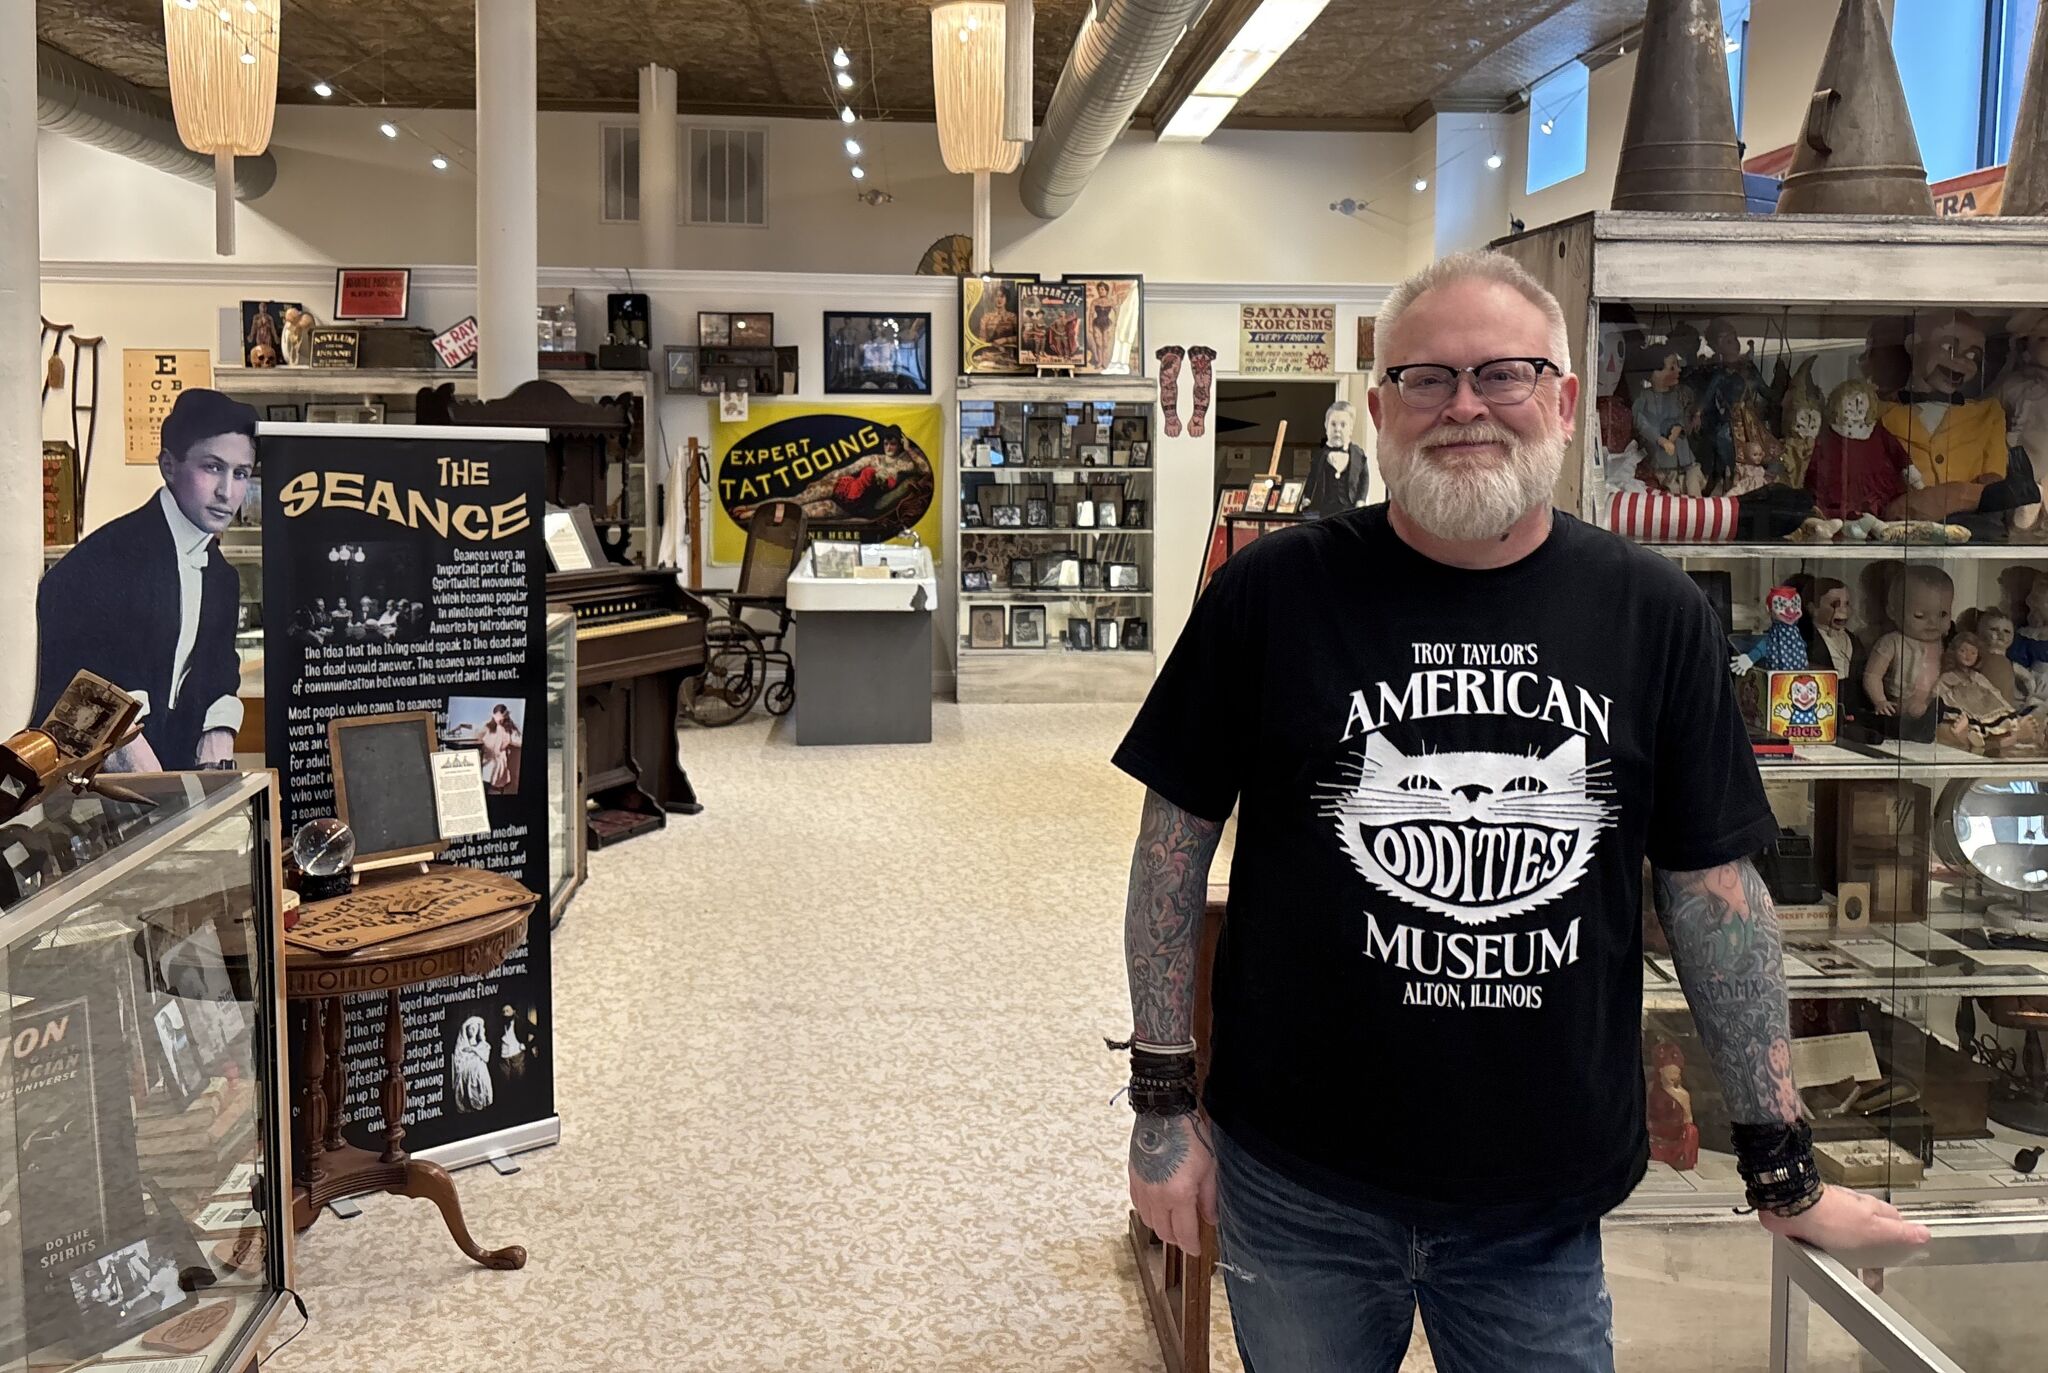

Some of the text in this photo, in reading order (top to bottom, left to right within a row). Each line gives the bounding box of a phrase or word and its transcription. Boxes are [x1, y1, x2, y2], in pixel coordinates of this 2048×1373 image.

[1243, 306, 1334, 319] SATANIC
[1243, 319, 1333, 331] EXORCISMS
[1254, 333, 1284, 342] EVERY
[155, 355, 176, 375] E
[444, 350, 461, 366] IN
[1269, 363, 1276, 372] 5
[1284, 363, 1291, 372] 8
[151, 380, 182, 391] C B
[730, 438, 811, 466] EXPERT
[720, 425, 881, 500] TATTOOING
[437, 457, 490, 487] THE
[279, 471, 530, 541] SEANCE
[807, 531, 861, 540] NE HERE
[453, 548, 525, 561] Seances were an
[436, 559, 526, 577] important part of the
[432, 576, 480, 592] Spiritualist
[432, 590, 528, 605] which became popular
[438, 604, 529, 618] in nineteenth-century
[430, 617, 527, 634] America by introducing
[305, 633, 528, 660] the idea that the living could speak to the dead and
[1412, 643, 1538, 665] TROY TAYLOR'S
[304, 650, 526, 678] the dead would answer. The seance was a method
[292, 666, 520, 696] of communication between this world and the next.
[288, 698, 442, 721] Most people who came to seances
[1338, 668, 1614, 744] AMERICAN
[289, 722, 326, 737] were in
[289, 739, 322, 752] was an
[290, 754, 304, 772] for
[290, 772, 324, 788] contact
[291, 788, 335, 803] who wer
[291, 806, 332, 820] a seance
[492, 824, 528, 839] medium
[468, 846, 476, 856] in
[477, 846, 482, 855] a
[484, 840, 508, 854] circle
[510, 841, 520, 851] or
[471, 858, 485, 870] the
[487, 855, 510, 868] table
[510, 850, 526, 866] and
[1373, 825, 1573, 903] ODDITIES
[1362, 910, 1582, 980] MUSEUM
[502, 963, 528, 977] horns,
[366, 982, 499, 1018] and instruments flew
[1402, 982, 1543, 1010] ALTON, ILLINOIS
[354, 1024, 368, 1038] the
[370, 1022, 386, 1034] roo
[428, 1006, 446, 1022] and
[348, 1036, 379, 1056] moved
[406, 1040, 444, 1060] adept at
[344, 1054, 444, 1076] ediums and could
[16, 1070, 77, 1095] UNIVERSE
[414, 1074, 444, 1090] among
[356, 1091, 368, 1104] up
[370, 1087, 380, 1100] to
[426, 1088, 443, 1104] and
[416, 1107, 443, 1121] them.
[46, 1229, 90, 1251] DO THE
[40, 1239, 96, 1269] SPIRITS
